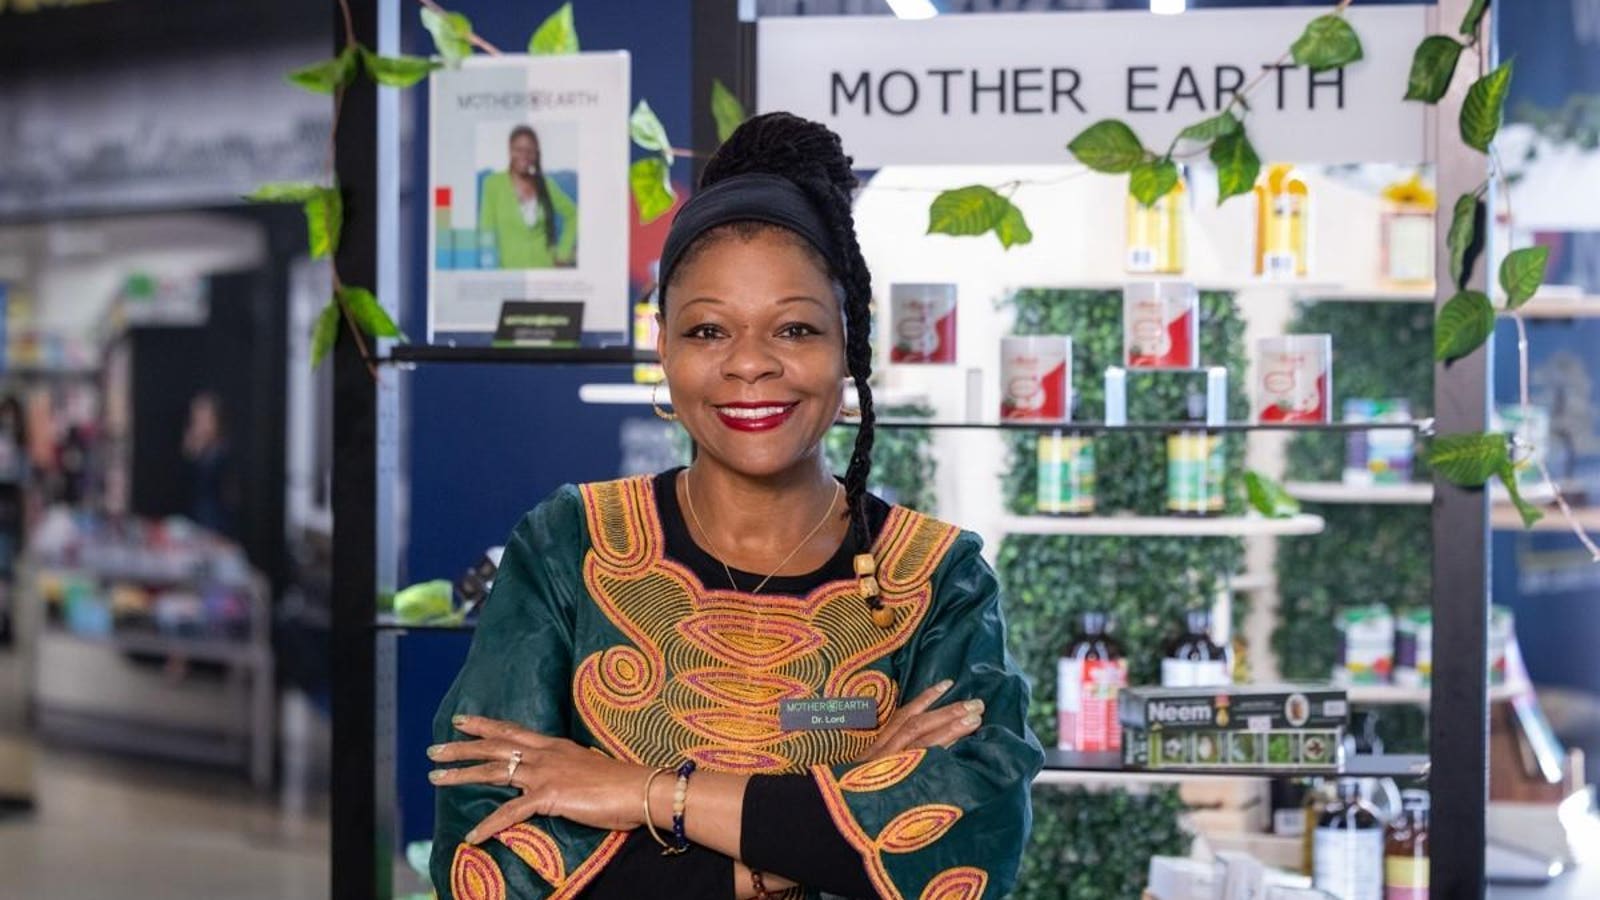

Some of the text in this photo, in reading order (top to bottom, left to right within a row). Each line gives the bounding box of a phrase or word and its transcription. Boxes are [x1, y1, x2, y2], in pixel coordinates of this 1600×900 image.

[831, 64, 1344, 116] MOTHER EARTH
[786, 700, 869, 712] MOTHER EARTH
[1148, 702, 1212, 721] Neem
[811, 715, 846, 724] Dr. Lord
